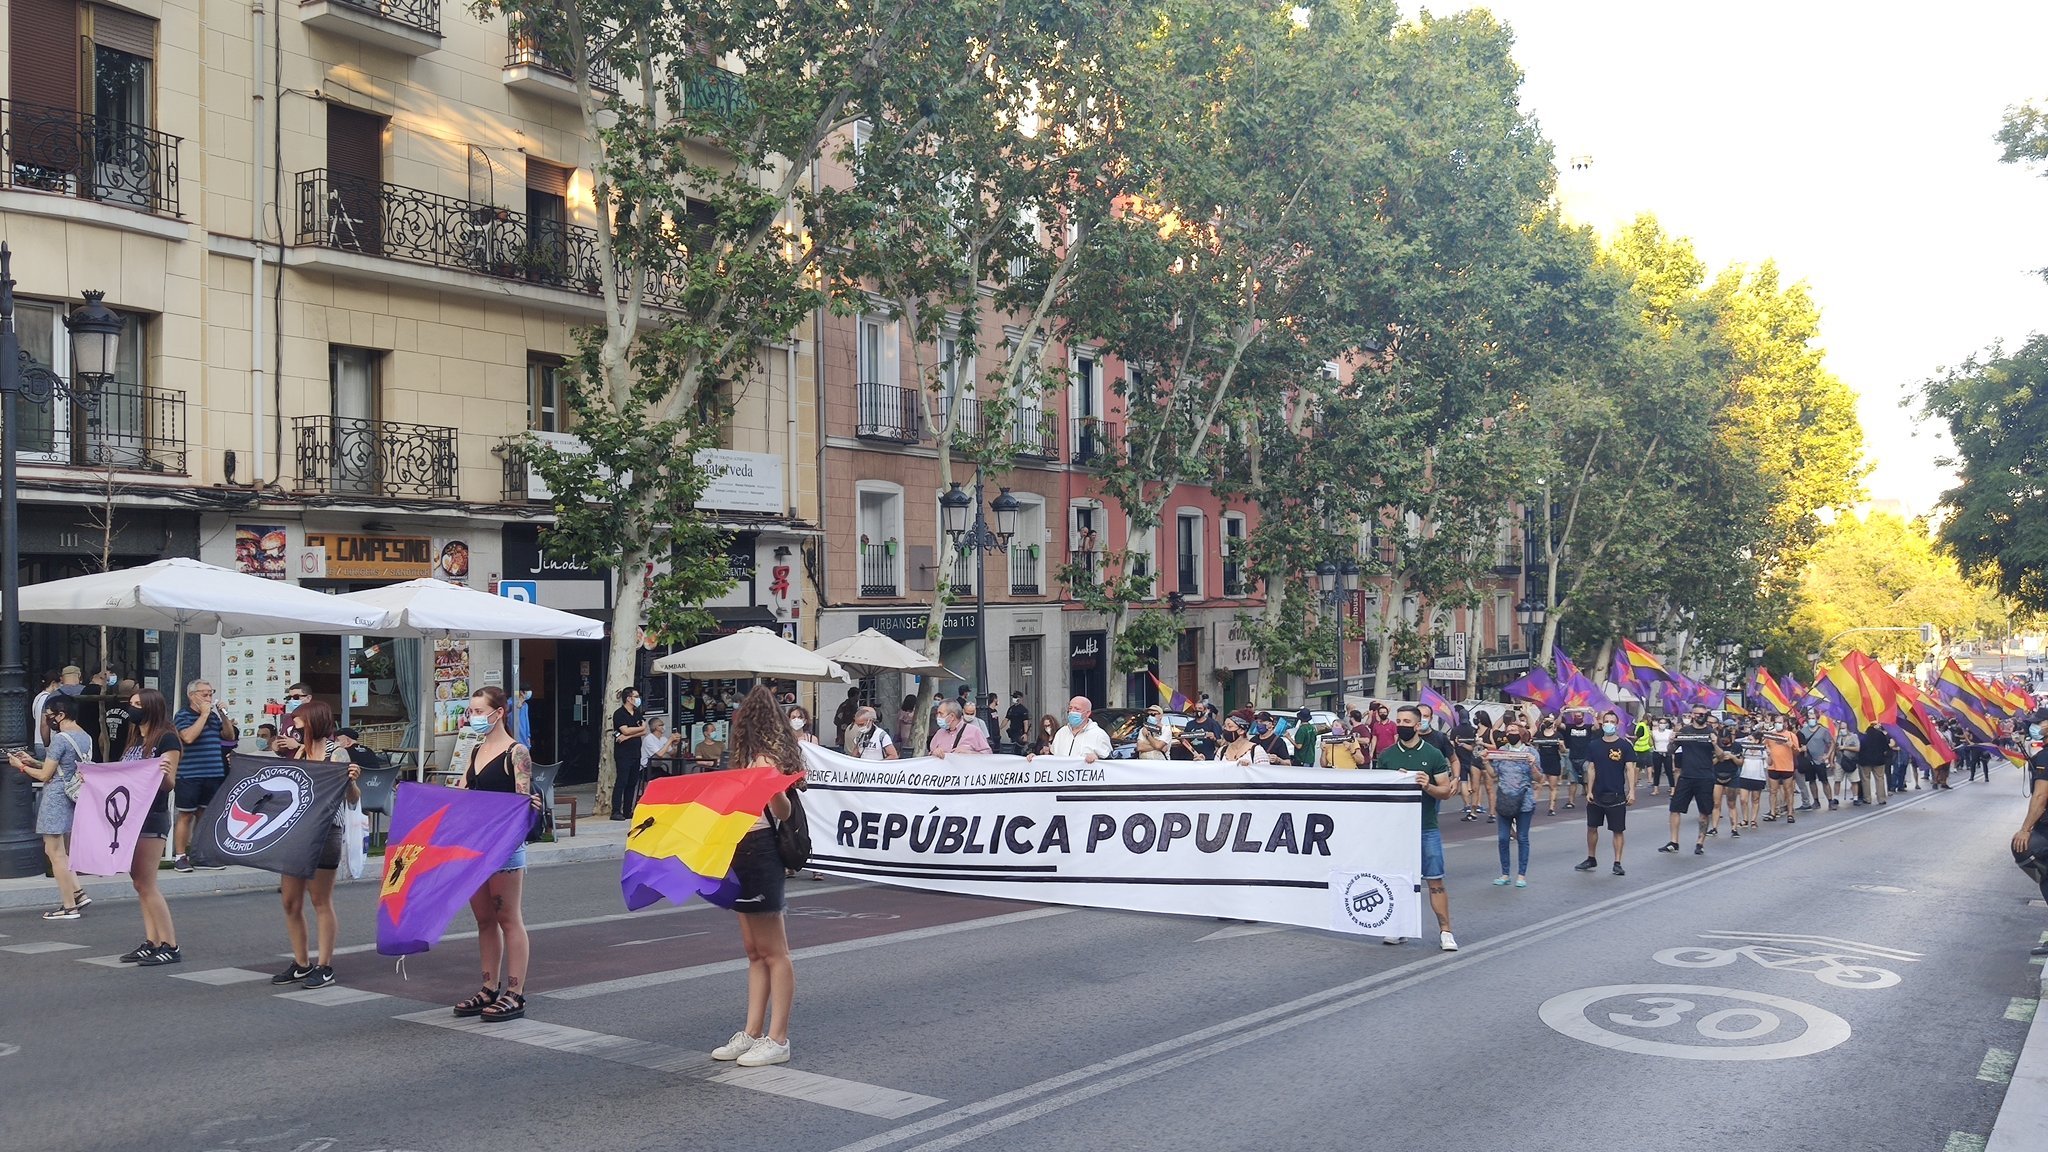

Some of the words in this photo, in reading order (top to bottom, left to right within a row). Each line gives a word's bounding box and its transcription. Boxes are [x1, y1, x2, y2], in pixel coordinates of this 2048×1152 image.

[60, 533, 78, 547] 111
[337, 536, 431, 562] CAMPESINO
[943, 616, 957, 627] cha
[960, 616, 975, 627] 113
[807, 769, 832, 783] RENTE
[850, 769, 906, 785] MONARQUÍA
[907, 774, 962, 788] CORRUPTA
[963, 775, 969, 788] Y
[970, 773, 987, 787] LAS
[988, 771, 1031, 785] MISERIAS
[1034, 770, 1054, 784] DEL
[1056, 768, 1106, 783] SISTEMA
[836, 805, 1071, 855] REPÚBLICA
[1086, 812, 1335, 856] POPULAR
[222, 837, 254, 851] MADRID
[1344, 879, 1354, 895] NADIE
[1372, 874, 1384, 884] QUE
[1383, 883, 1394, 901] NADIE
[1344, 897, 1353, 917] NADIE
[1351, 916, 1359, 924] ES
[1372, 919, 1385, 929] QUE
[1383, 902, 1394, 921] NADIE
[1608, 997, 1780, 1040] 30
